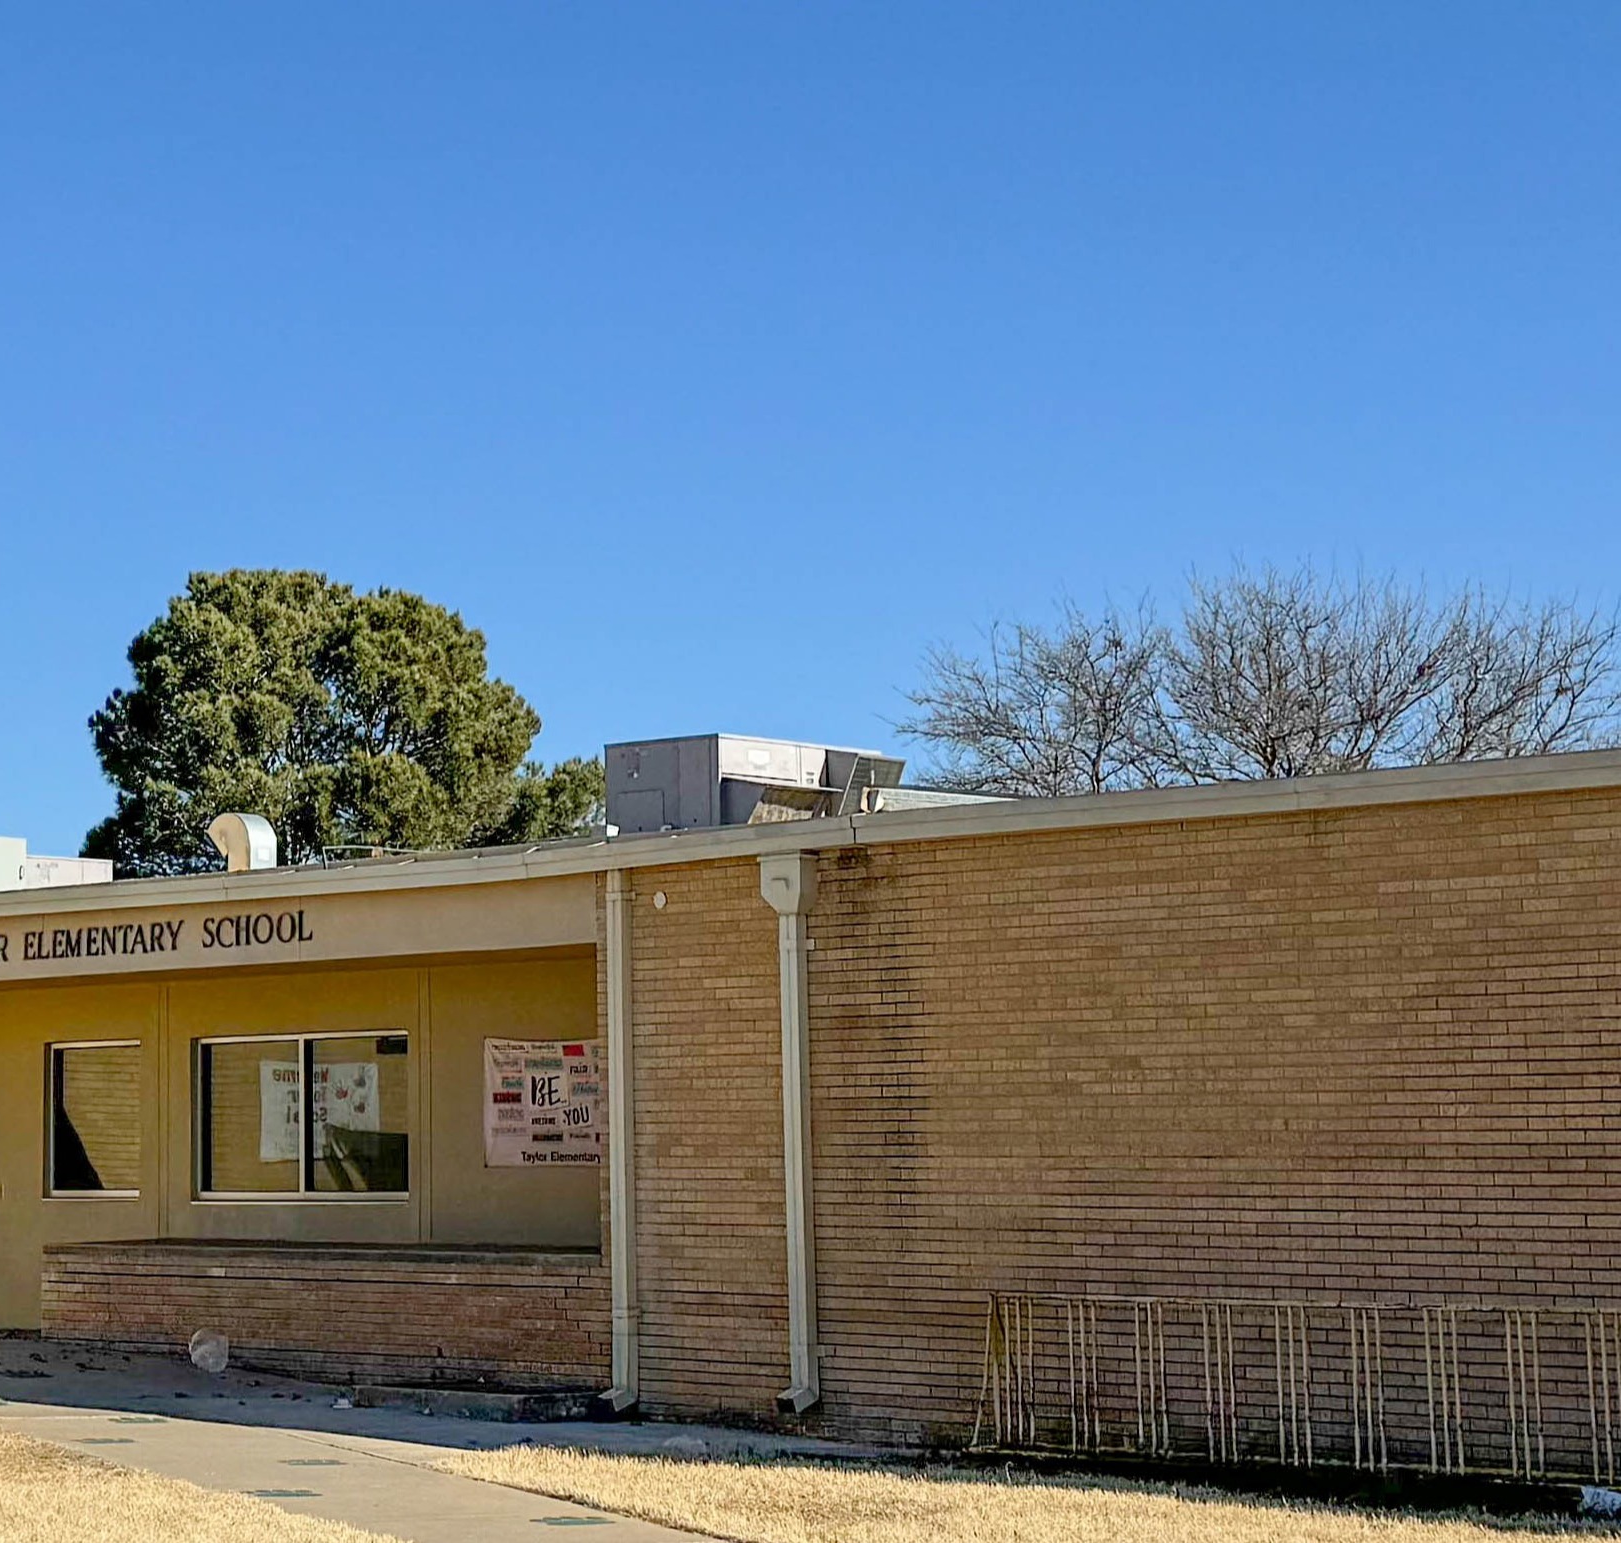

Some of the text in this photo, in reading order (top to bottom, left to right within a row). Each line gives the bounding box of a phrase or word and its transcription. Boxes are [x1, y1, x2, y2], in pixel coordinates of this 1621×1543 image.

[23, 919, 185, 961] ELEMENTARY
[202, 910, 313, 949] SCHOOL
[521, 1151, 601, 1164] Taylor Elementary
